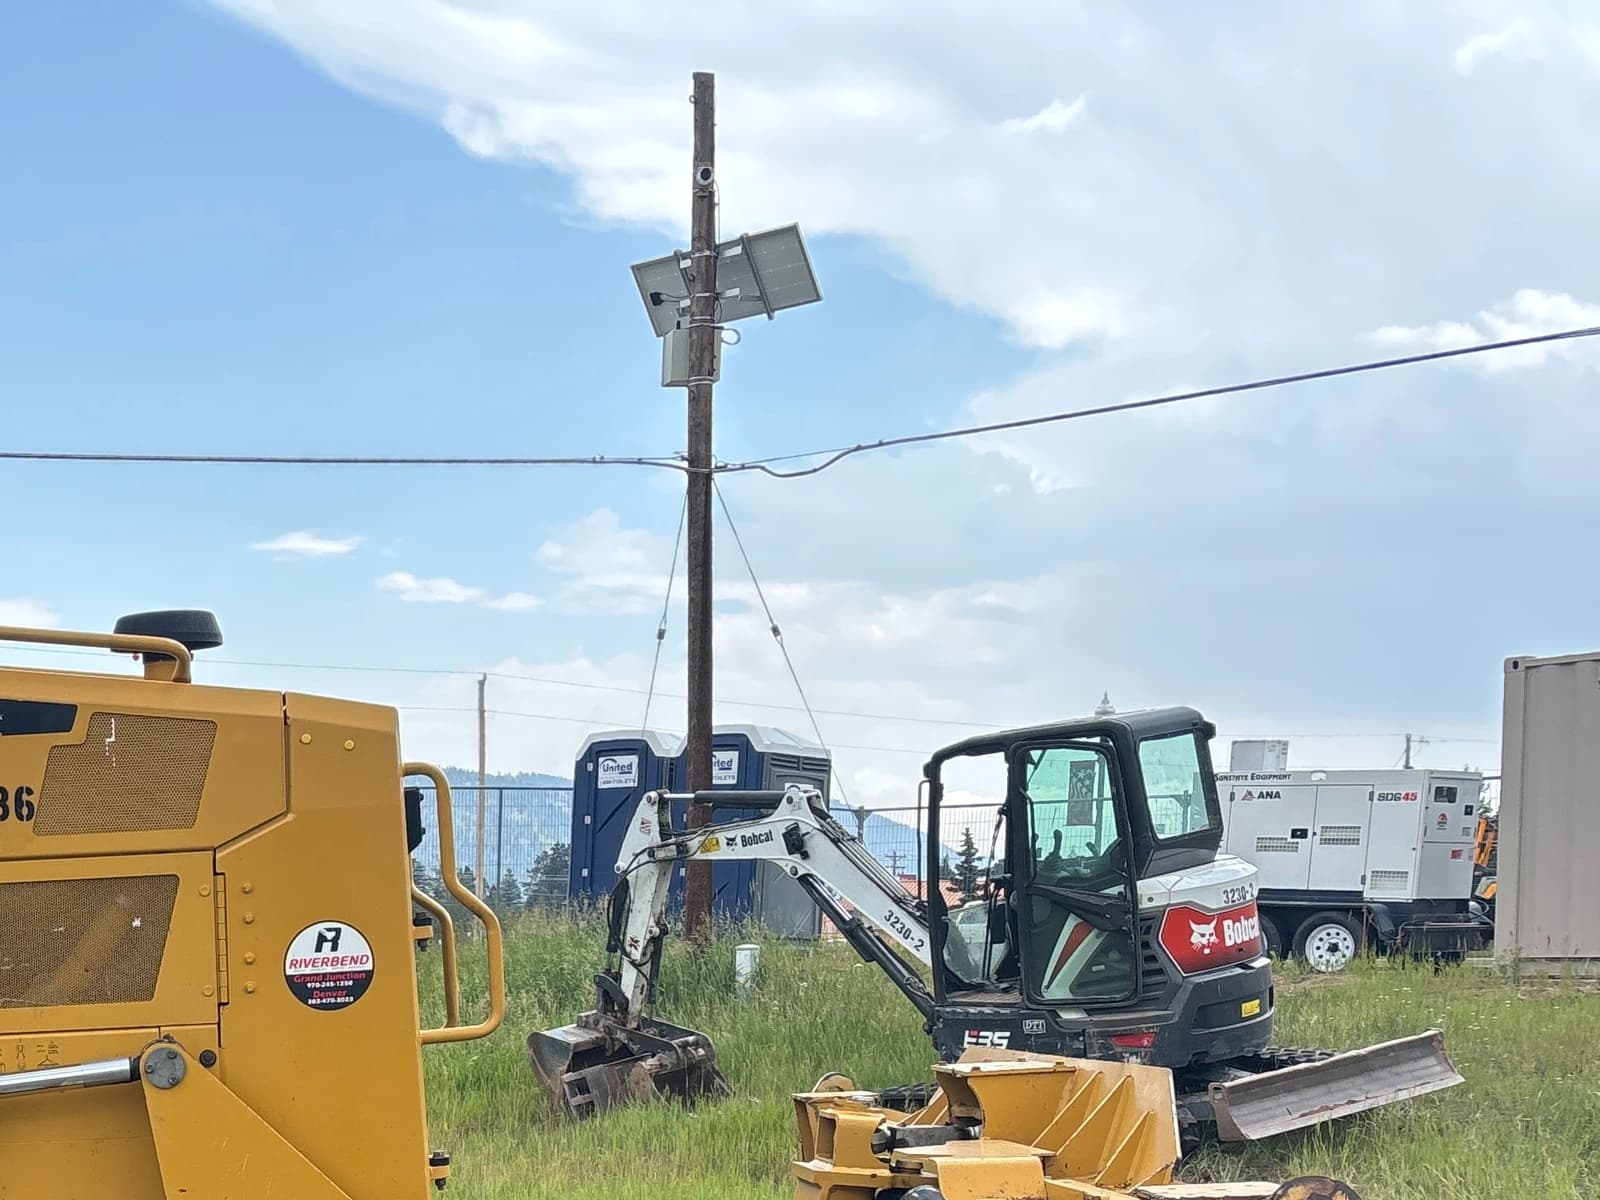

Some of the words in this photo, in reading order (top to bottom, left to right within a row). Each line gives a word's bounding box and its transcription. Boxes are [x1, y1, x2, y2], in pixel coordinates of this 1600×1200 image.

[602, 761, 633, 773] United
[713, 758, 733, 768] ited
[1257, 790, 1281, 800] ANA
[741, 829, 774, 848] Bobcat
[1223, 882, 1254, 904] 3230-2
[884, 909, 925, 952] 3230-2
[289, 954, 370, 970] RIVERBEND
[293, 974, 323, 984] Grand
[324, 972, 366, 981] Junction
[312, 990, 347, 998] Denver
